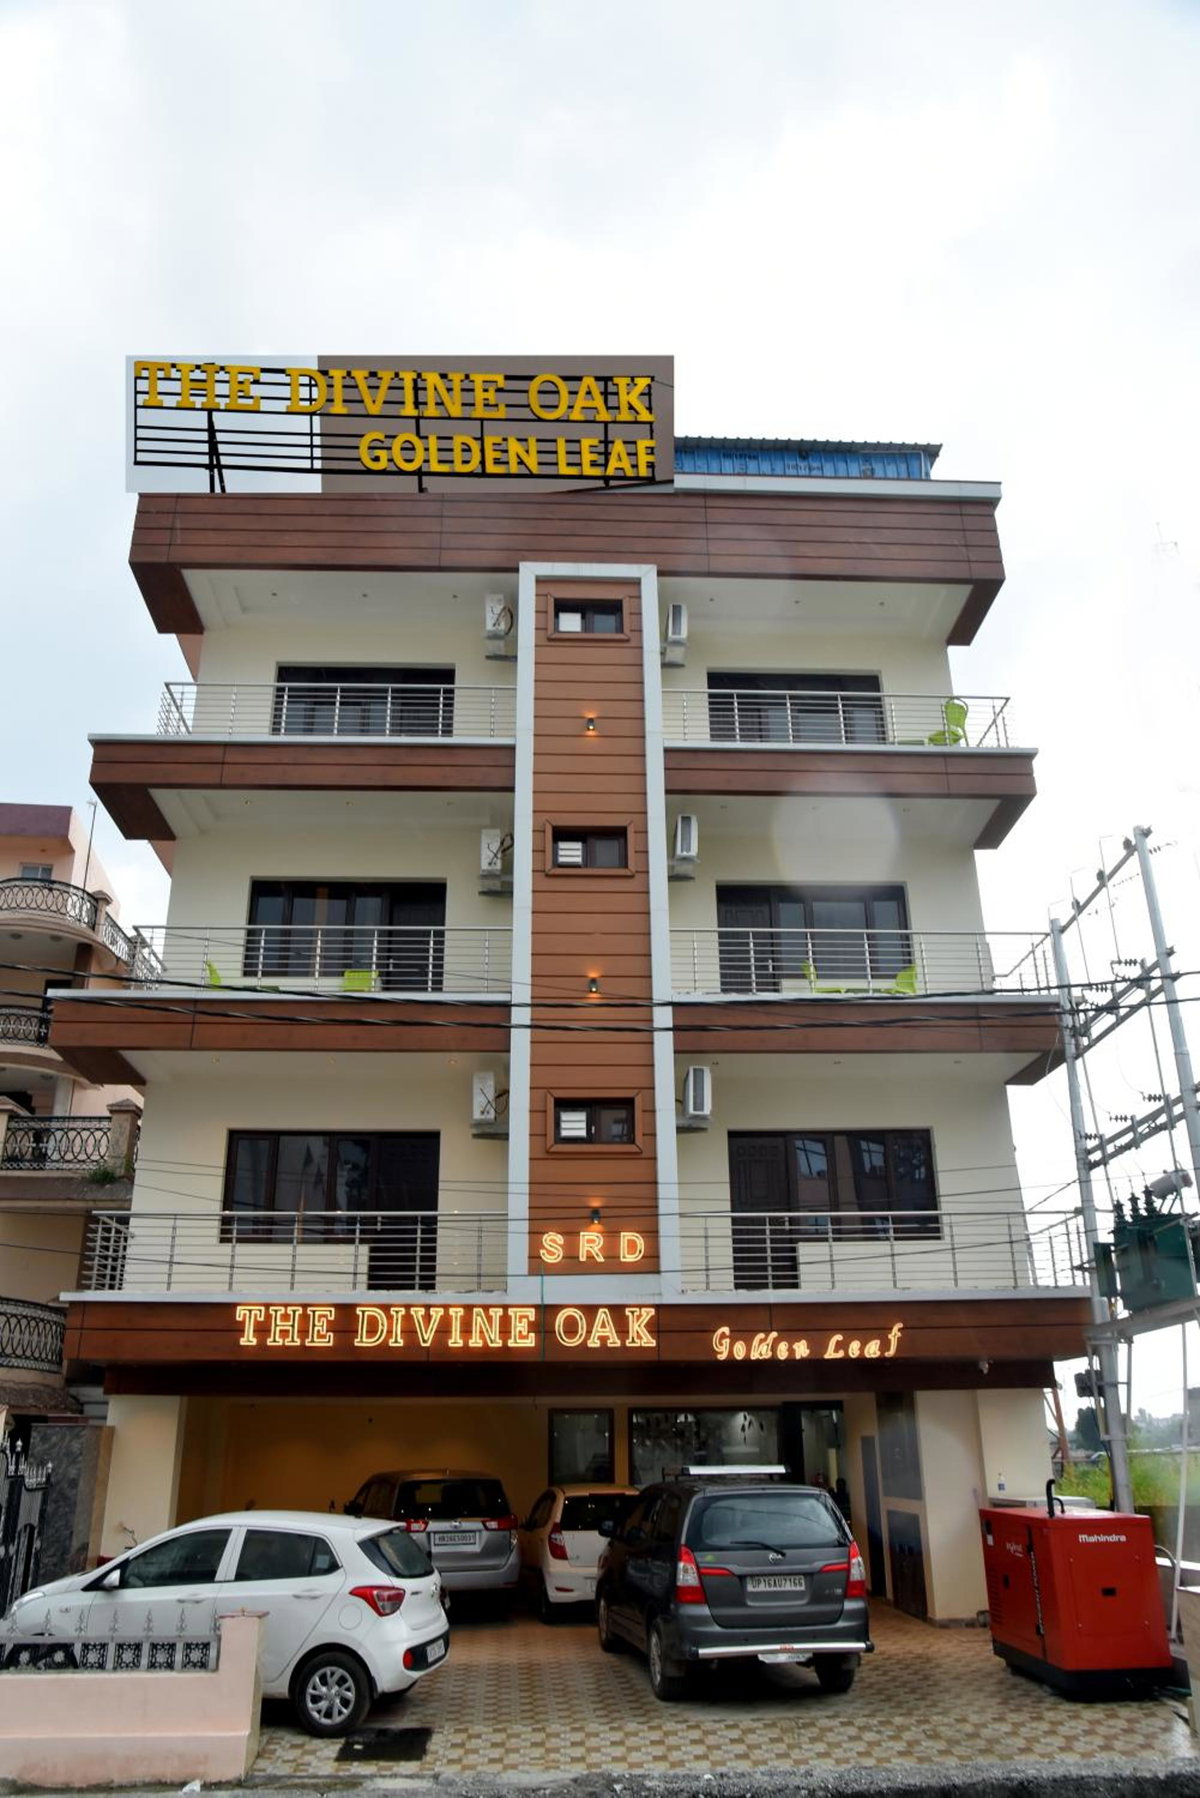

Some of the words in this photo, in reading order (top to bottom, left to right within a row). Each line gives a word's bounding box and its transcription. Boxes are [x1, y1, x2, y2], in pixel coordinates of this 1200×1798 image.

[134, 361, 260, 411] THE
[285, 367, 506, 419] DIVINE
[527, 374, 656, 423] OAK
[358, 430, 539, 477] GOLDEN
[556, 437, 657, 477] LEAF
[236, 1307, 335, 1347] THE
[354, 1307, 536, 1348] DIVINE
[554, 1307, 657, 1348] OAK
[713, 1326, 810, 1360] Golden
[823, 1322, 904, 1359] Leaf
[1078, 1534, 1127, 1543] Mahindra
